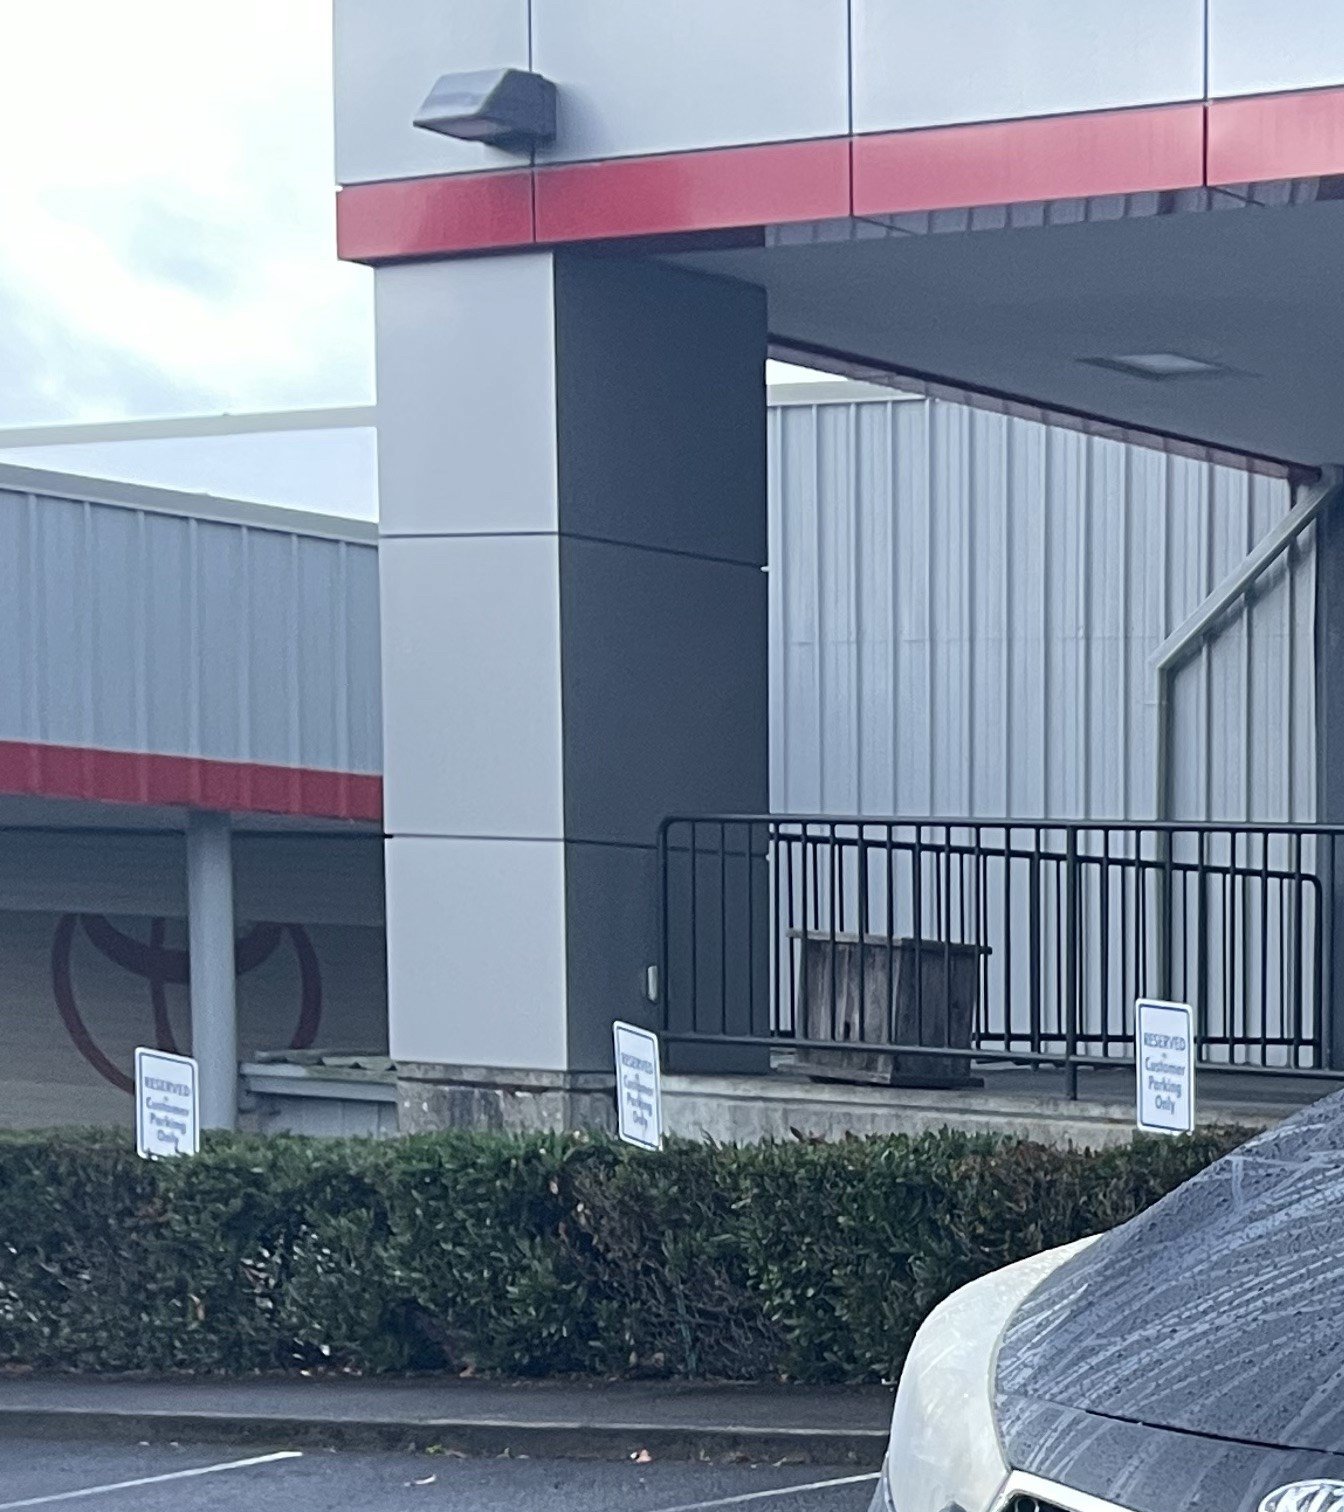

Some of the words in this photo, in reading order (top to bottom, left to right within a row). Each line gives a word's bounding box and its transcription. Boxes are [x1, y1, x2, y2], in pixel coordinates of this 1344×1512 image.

[1144, 1032, 1186, 1051] RESERVED
[621, 1052, 653, 1075] RESERVED
[1145, 1056, 1186, 1076] Customer
[145, 1076, 190, 1097] RESERVED
[623, 1074, 653, 1096] Customer
[1148, 1075, 1182, 1098] Parking
[146, 1097, 189, 1117] Customer
[627, 1092, 652, 1117] Parking
[1155, 1094, 1176, 1115] Only
[150, 1113, 186, 1135] Parking
[633, 1110, 648, 1131] Only
[157, 1130, 179, 1149] Only
